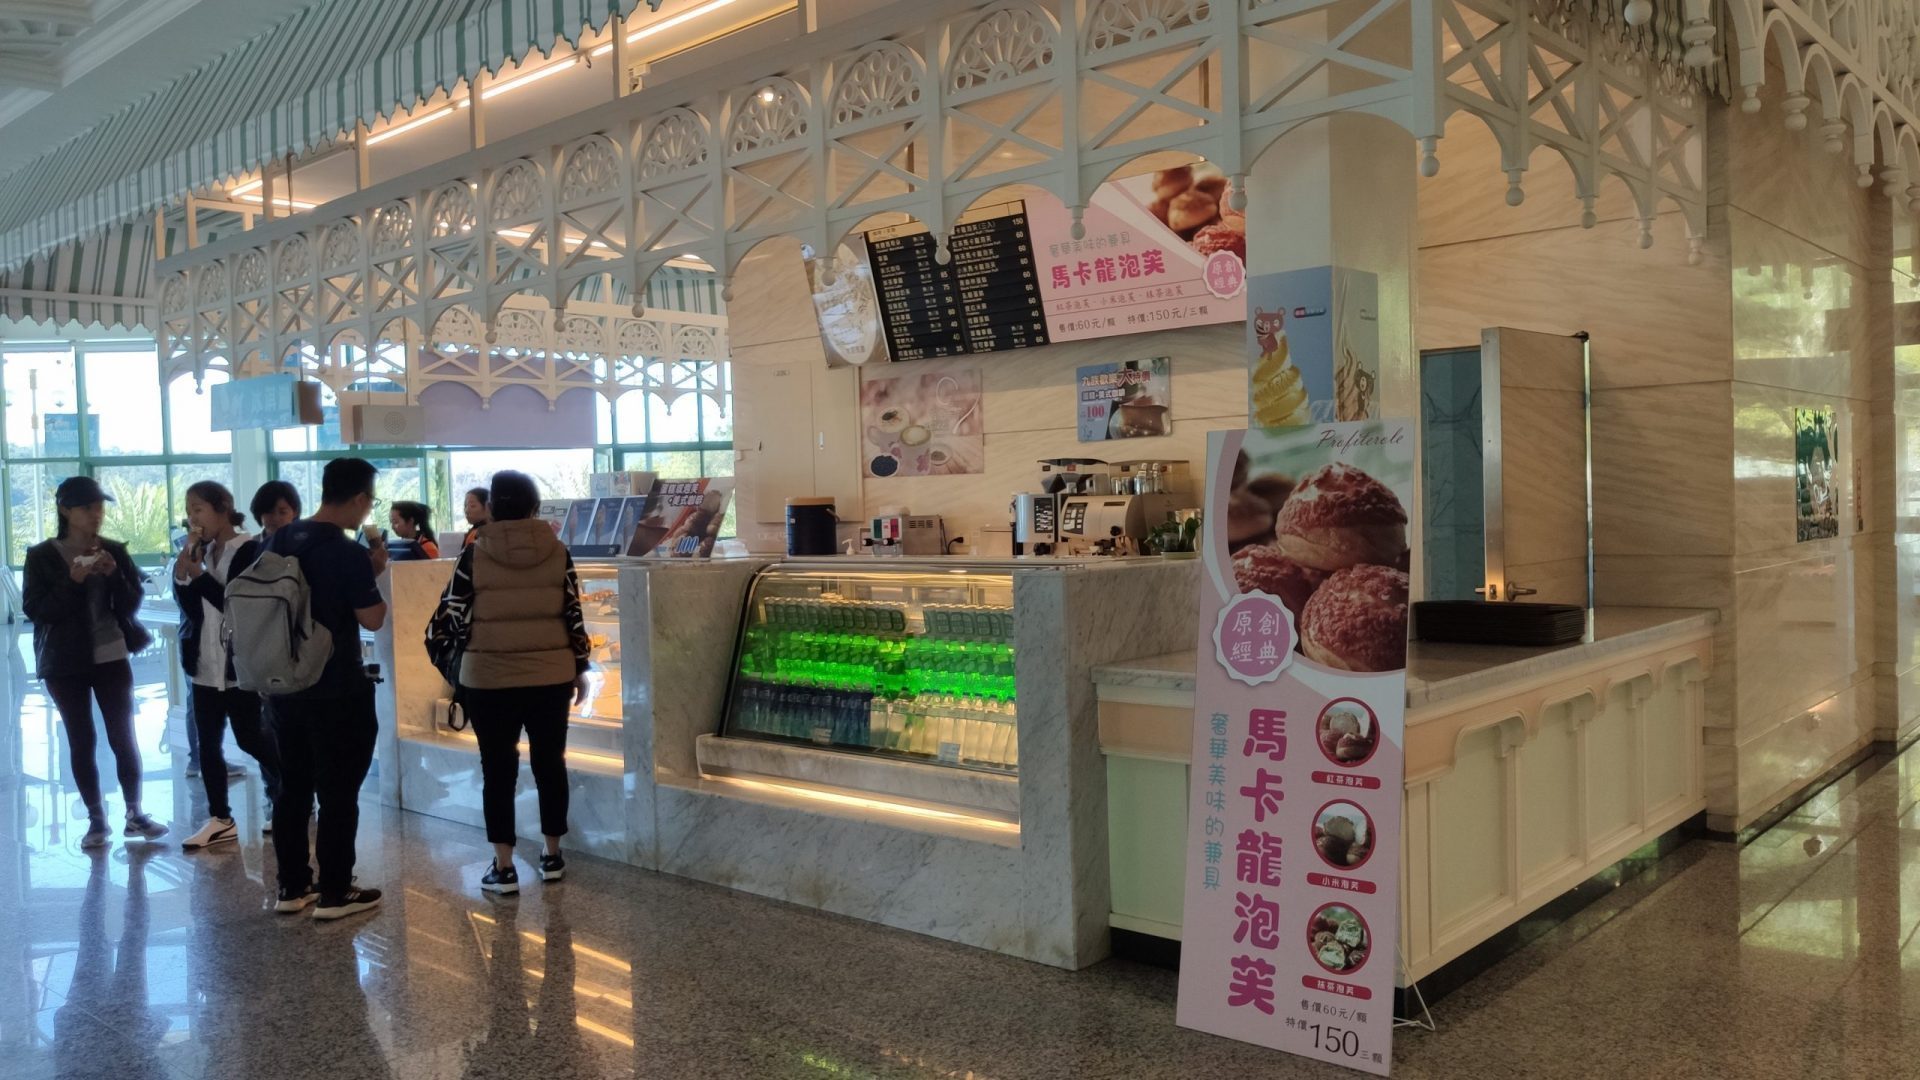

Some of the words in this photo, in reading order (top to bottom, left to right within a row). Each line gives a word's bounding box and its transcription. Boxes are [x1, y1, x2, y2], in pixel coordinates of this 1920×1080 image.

[1012, 217, 1024, 226] 150
[1052, 250, 1165, 289] 馬卡龍泡芙
[1212, 260, 1237, 275] 原創
[1213, 275, 1239, 289] 經典
[1087, 405, 1105, 418] 100
[1316, 427, 1404, 455] Profiterole
[676, 536, 700, 554] 100
[1231, 611, 1280, 637] 原創
[1229, 640, 1279, 665] 經典
[1326, 774, 1363, 787] 紅茶泡芙
[1203, 712, 1229, 891] 奢華美味的兼具
[1227, 708, 1287, 1016] 馬卡龍泡芙
[1322, 874, 1359, 891] 小米泡芙
[1316, 979, 1355, 996] 抹茶泡芙
